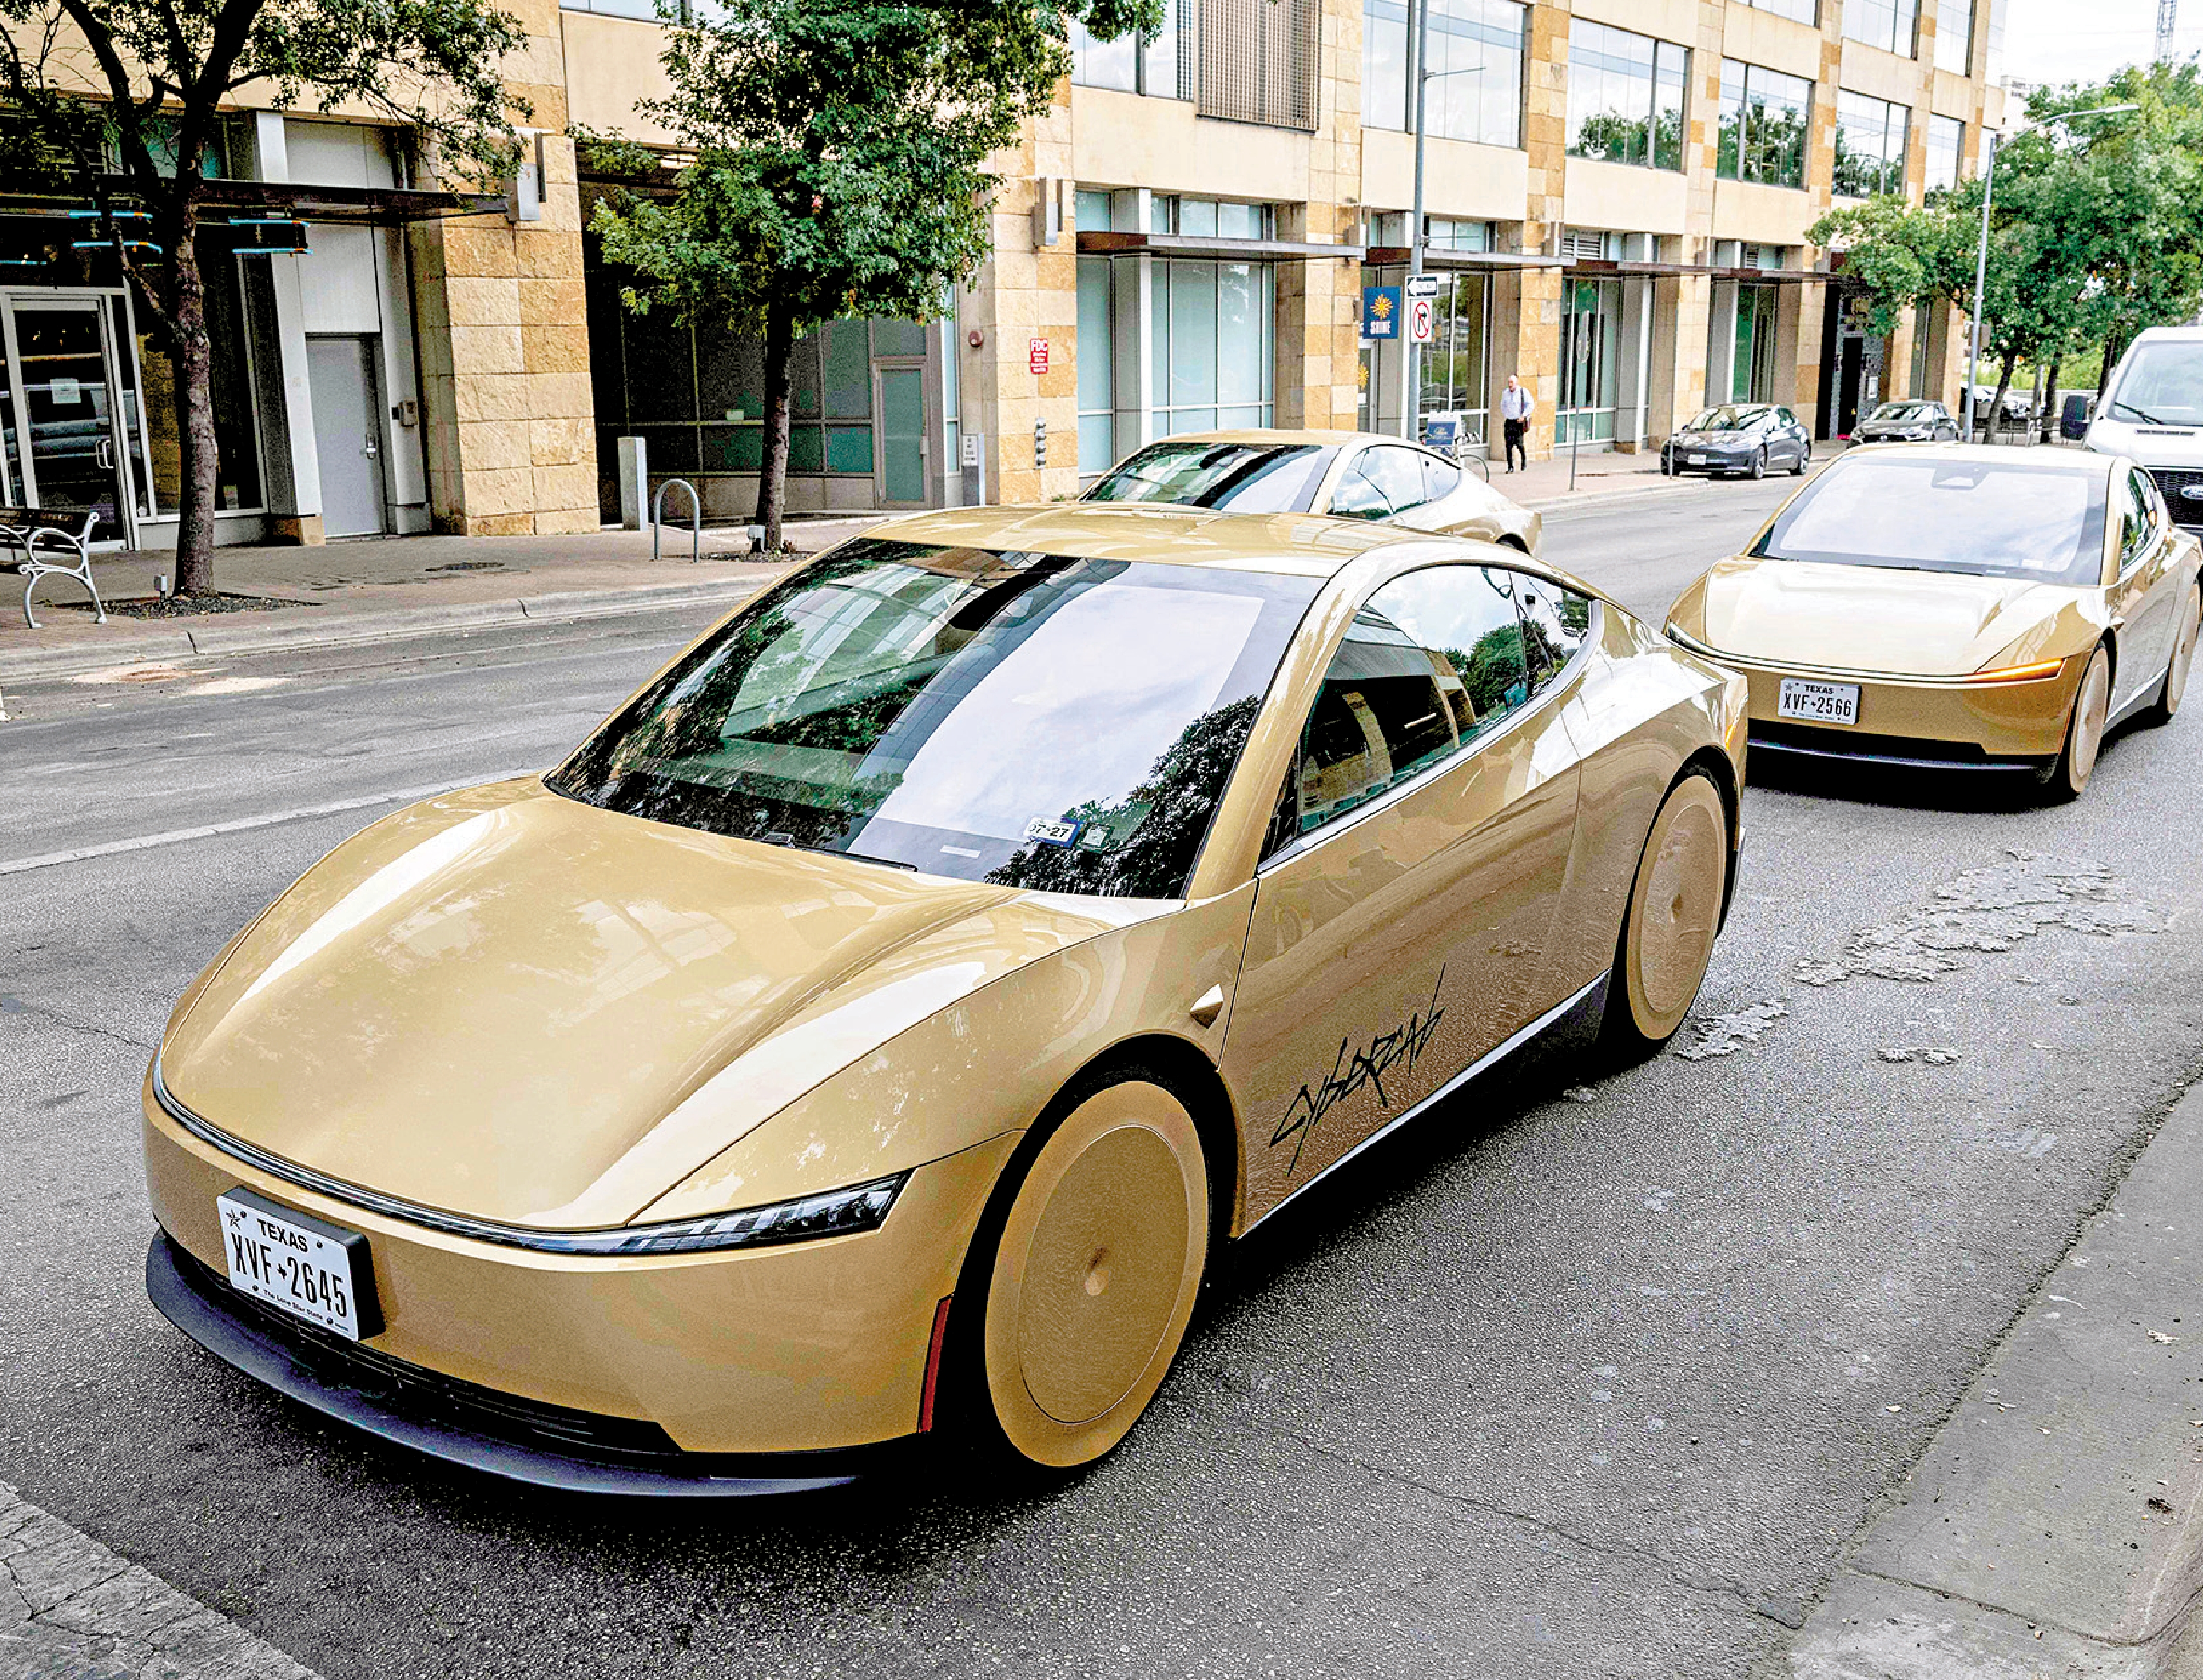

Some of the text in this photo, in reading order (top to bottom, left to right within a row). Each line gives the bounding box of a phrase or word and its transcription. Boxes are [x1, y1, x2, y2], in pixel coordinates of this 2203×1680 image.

[1031, 339, 1048, 352] FDC
[1804, 684, 1834, 694] TEXAS
[257, 1218, 308, 1252] TEXAS
